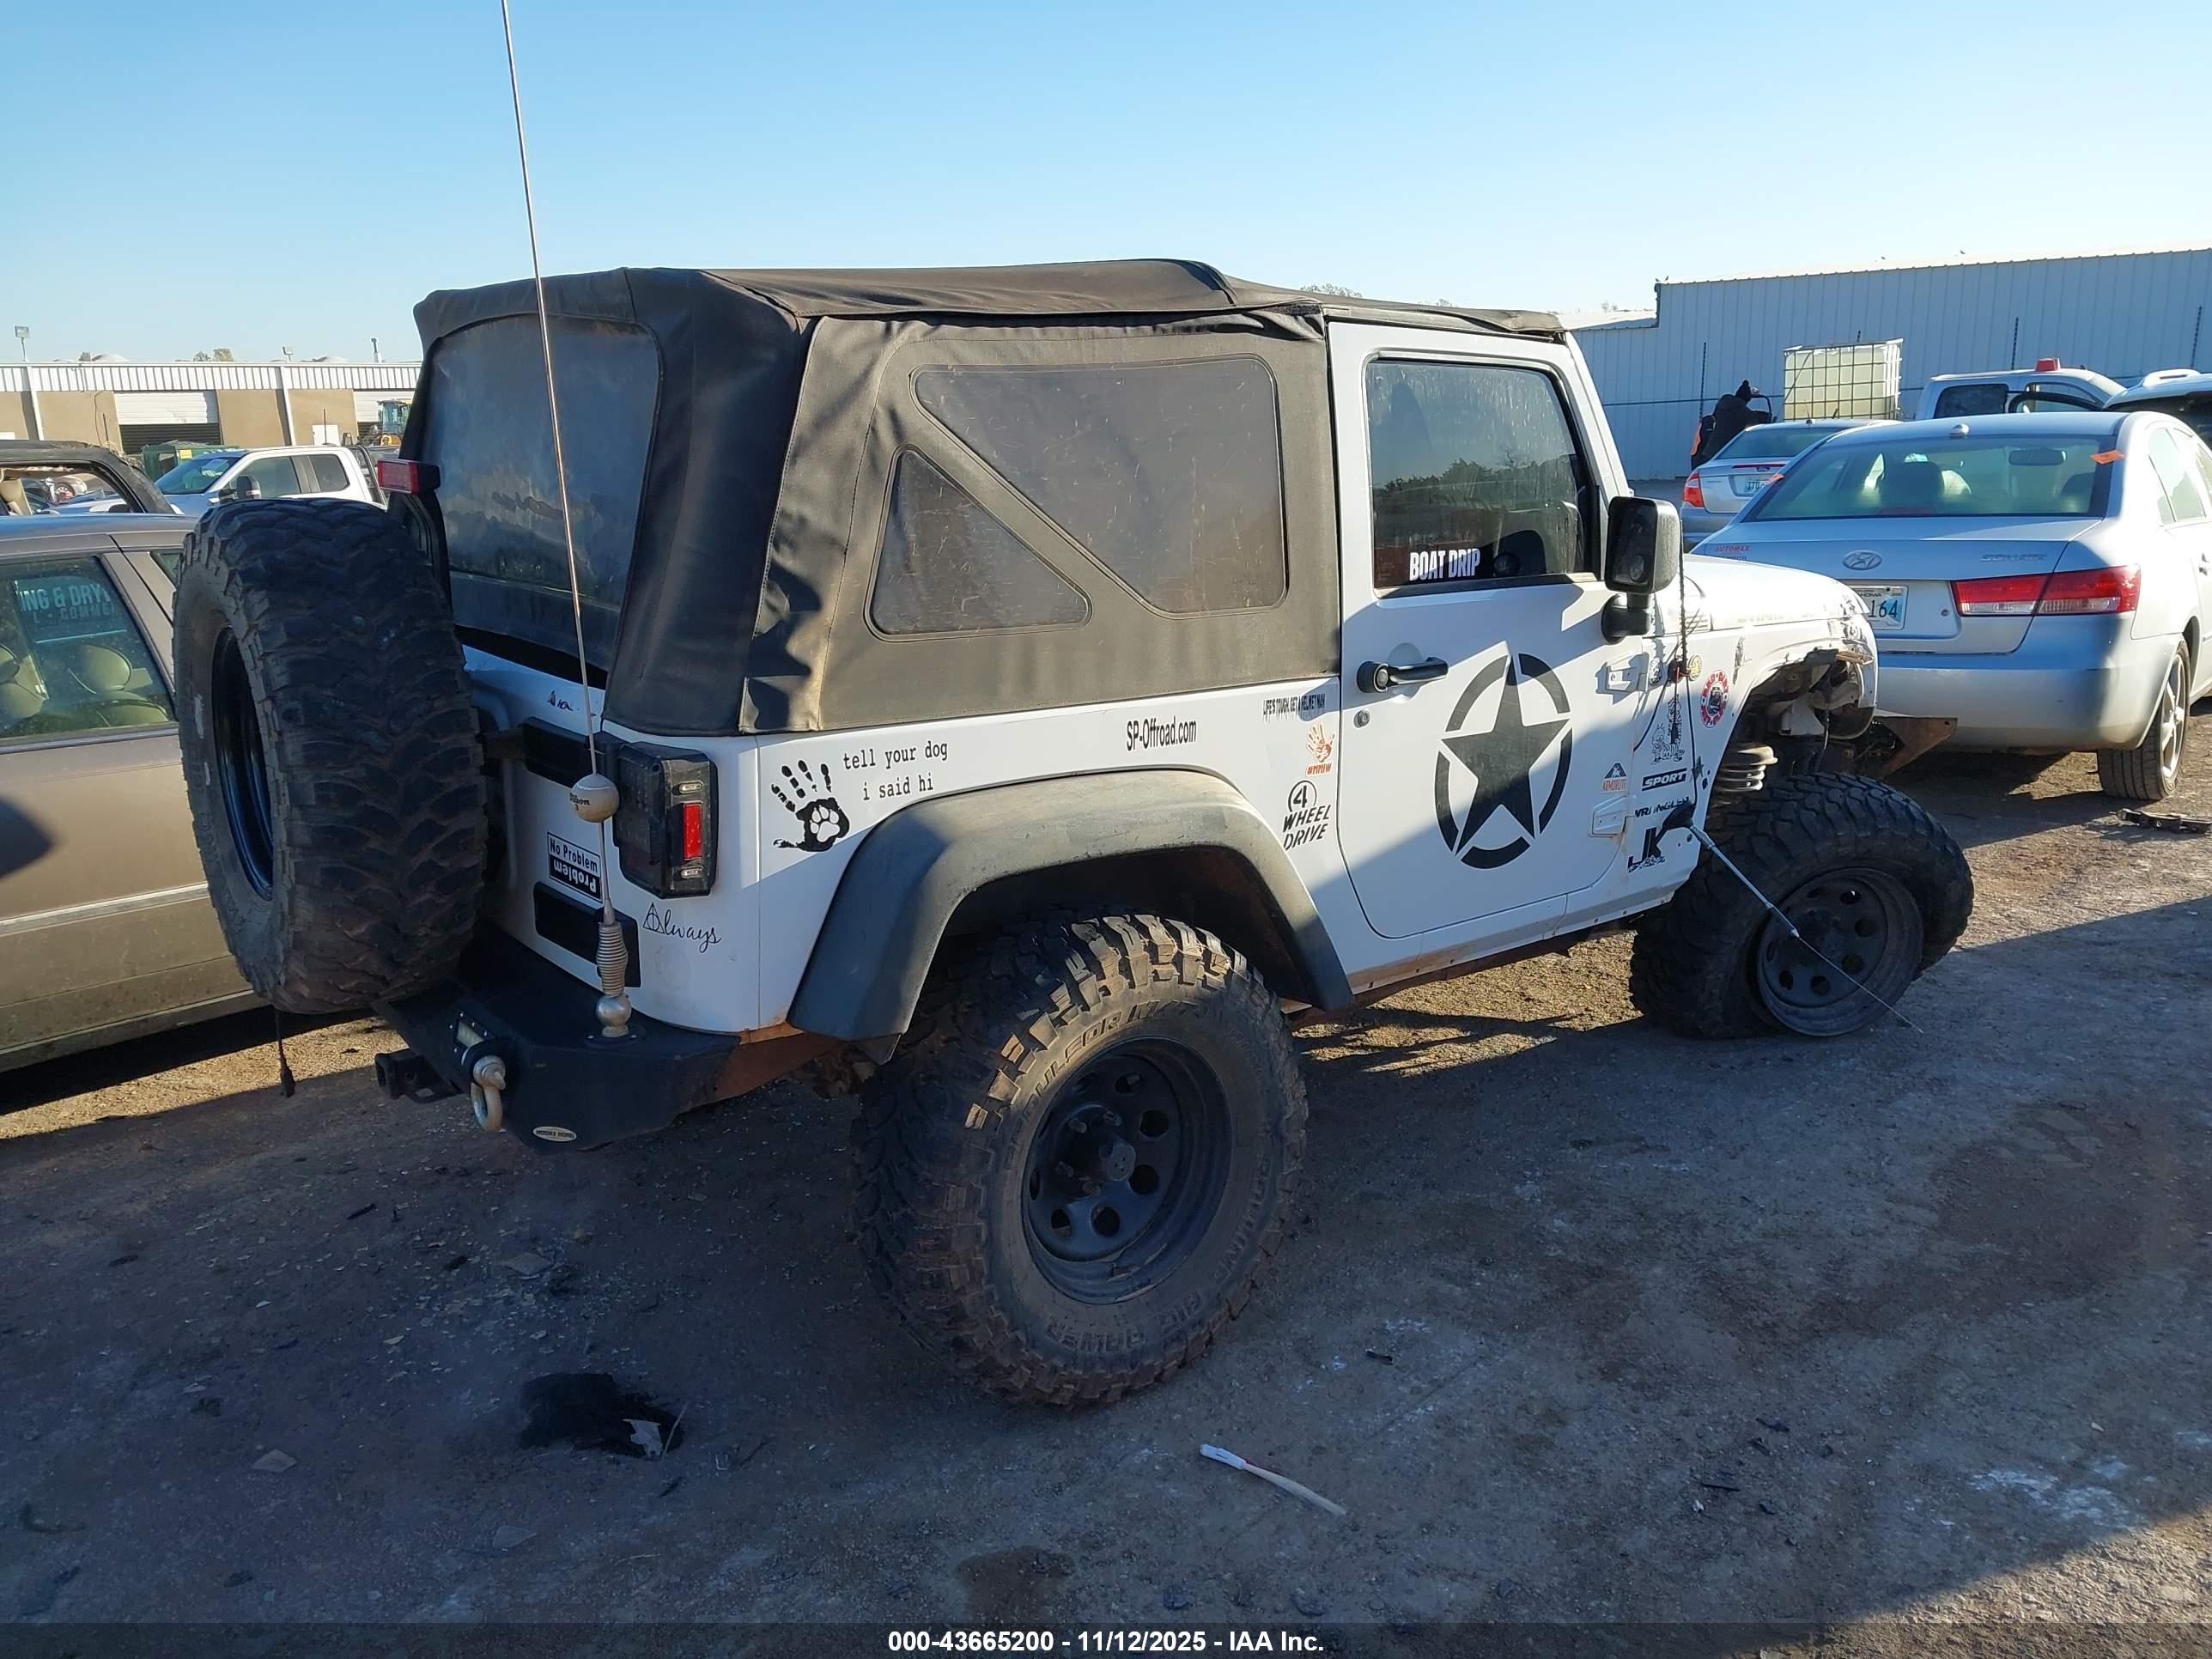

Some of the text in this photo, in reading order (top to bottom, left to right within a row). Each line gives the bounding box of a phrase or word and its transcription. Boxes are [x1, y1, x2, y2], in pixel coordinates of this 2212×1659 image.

[1409, 548, 1480, 580] BOAT DRIP
[1979, 554, 2047, 562] SONATA
[20, 588, 50, 612] ING
[1868, 599, 1899, 618] 164
[1126, 714, 1197, 751] SP-Offroad.com
[843, 740, 948, 769] tell your dog
[863, 772, 933, 801] i said hi
[1644, 774, 1685, 787] SPORT
[1292, 785, 1307, 808] 4
[1283, 805, 1331, 833] WHEEL
[1283, 823, 1328, 851] DRIVE
[1627, 826, 1662, 872] JK
[550, 837, 599, 873] No Problem
[553, 859, 597, 893] Problem
